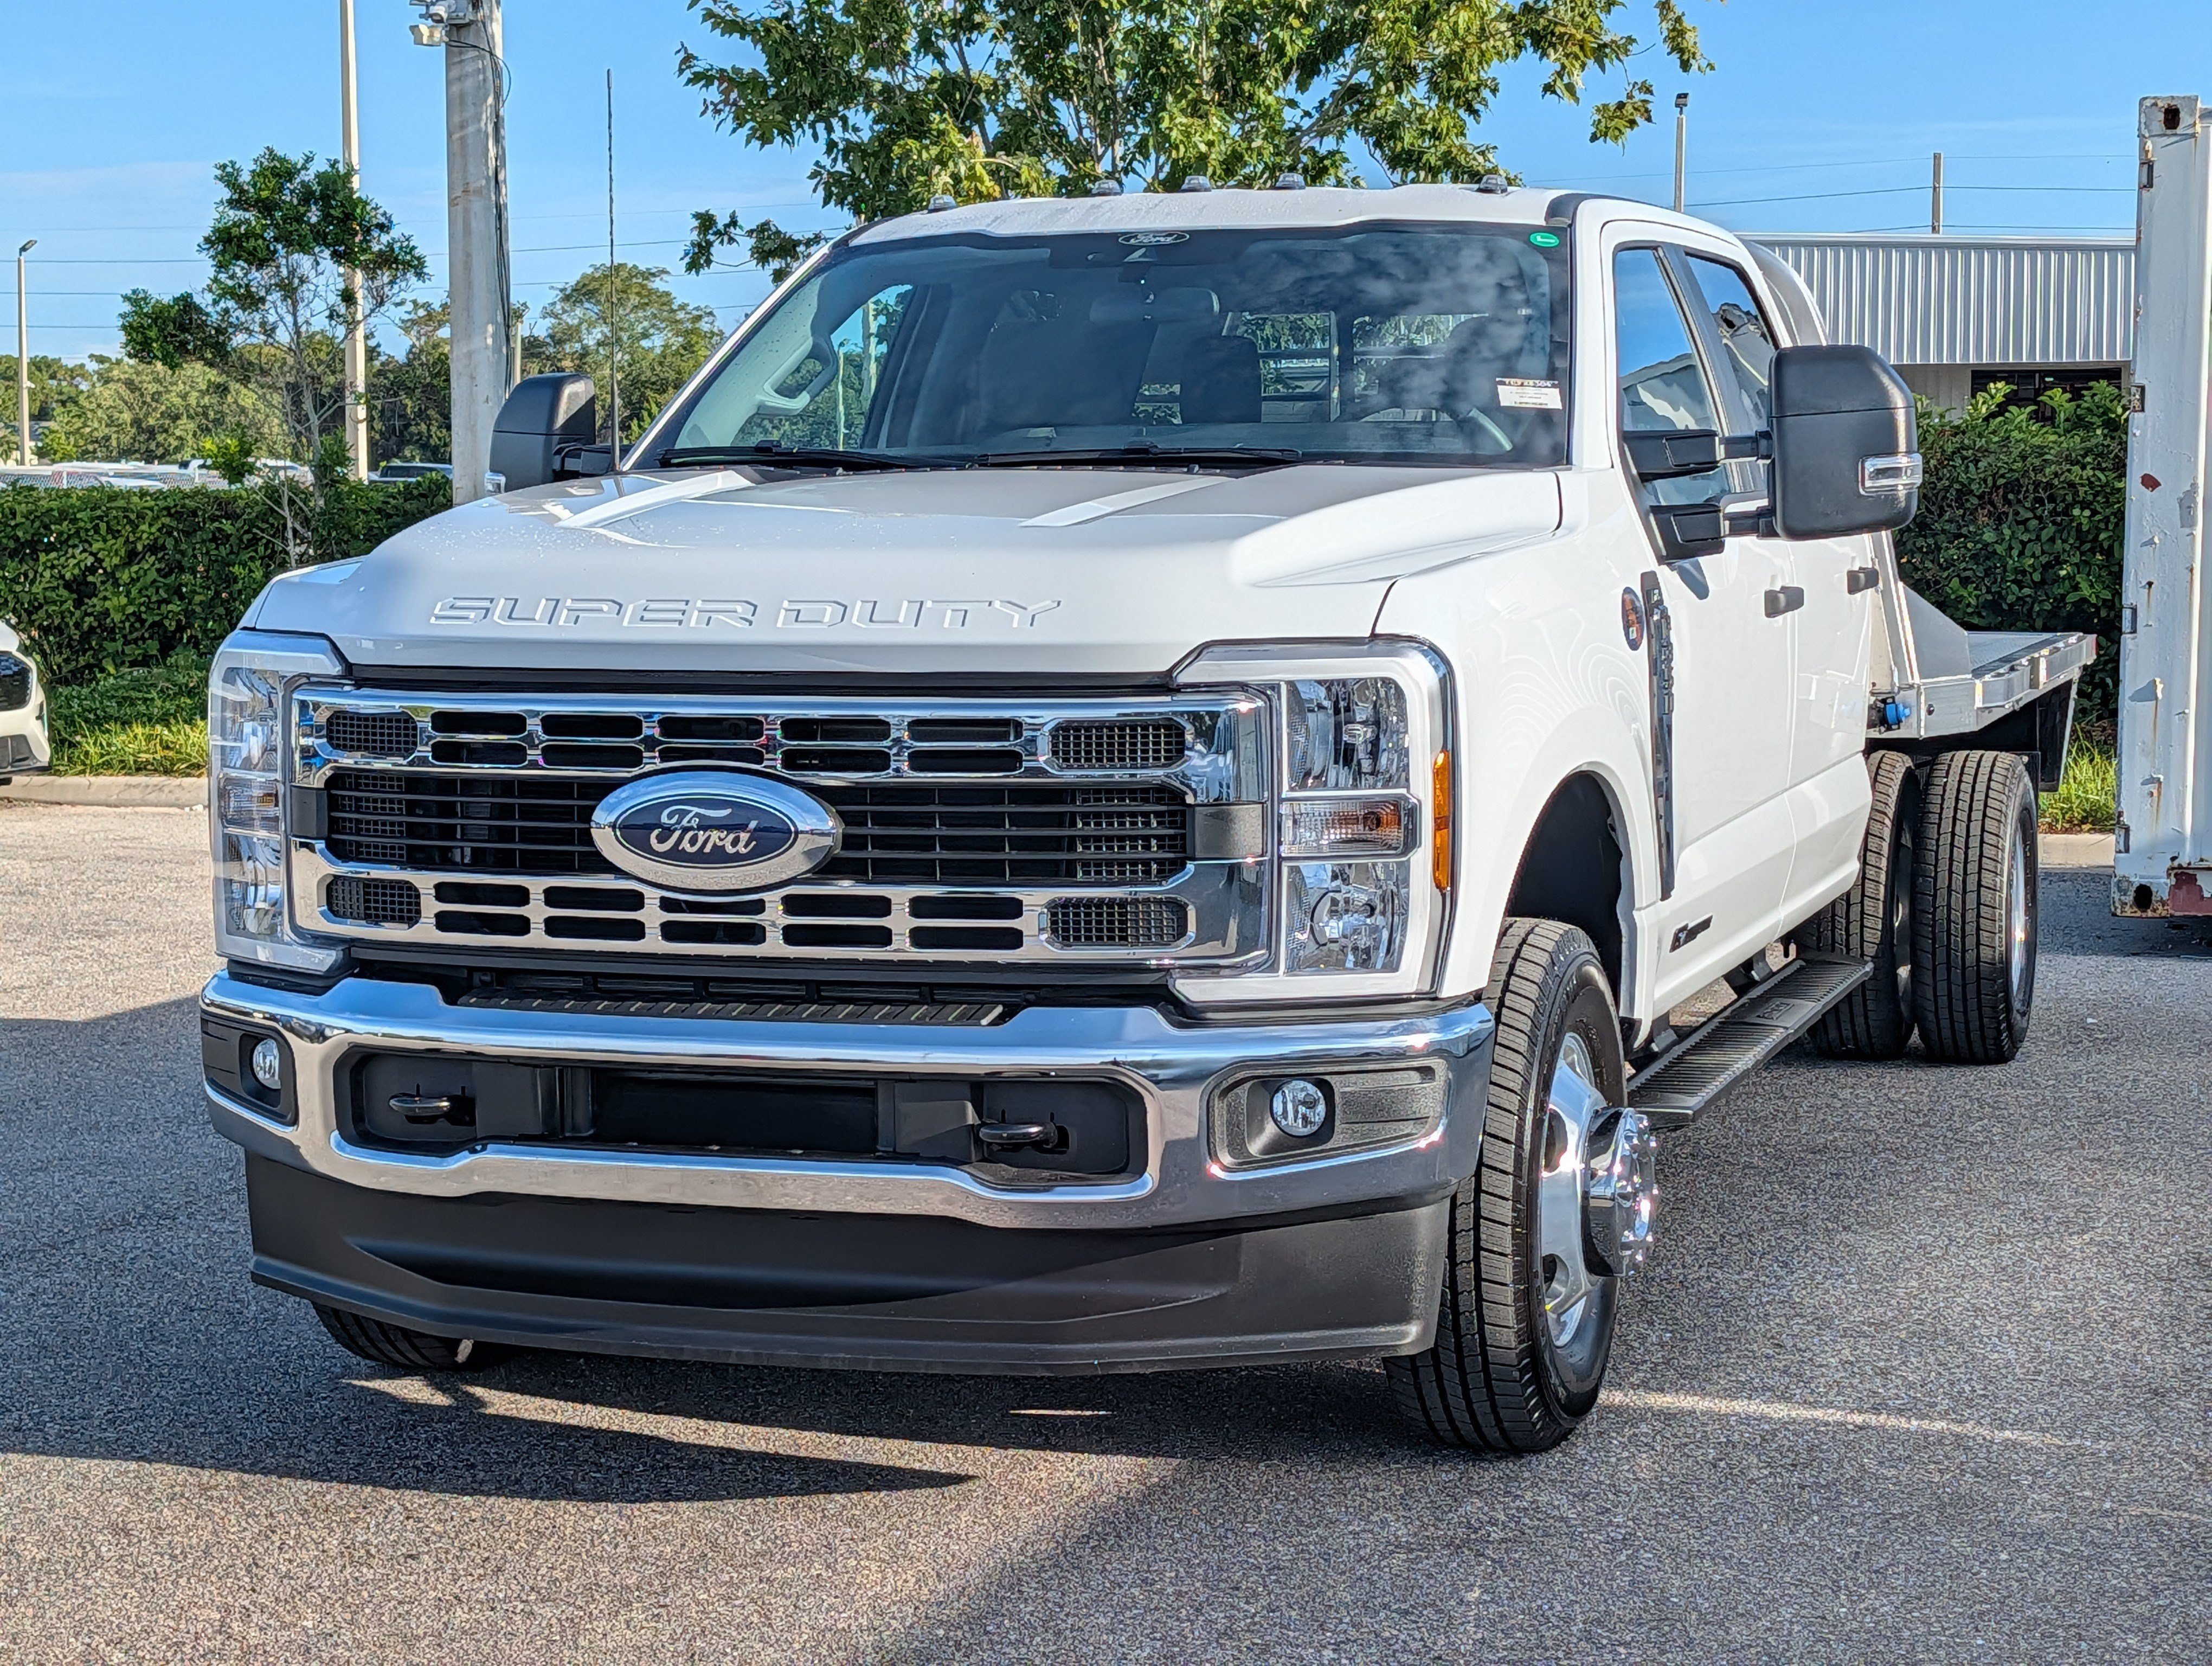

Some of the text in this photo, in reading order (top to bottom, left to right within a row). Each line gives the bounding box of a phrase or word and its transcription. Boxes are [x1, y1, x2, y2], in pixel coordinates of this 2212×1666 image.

[1129, 233, 1178, 244] Ford
[429, 597, 1063, 629] SUPER DUTY
[650, 804, 758, 854] Ford
